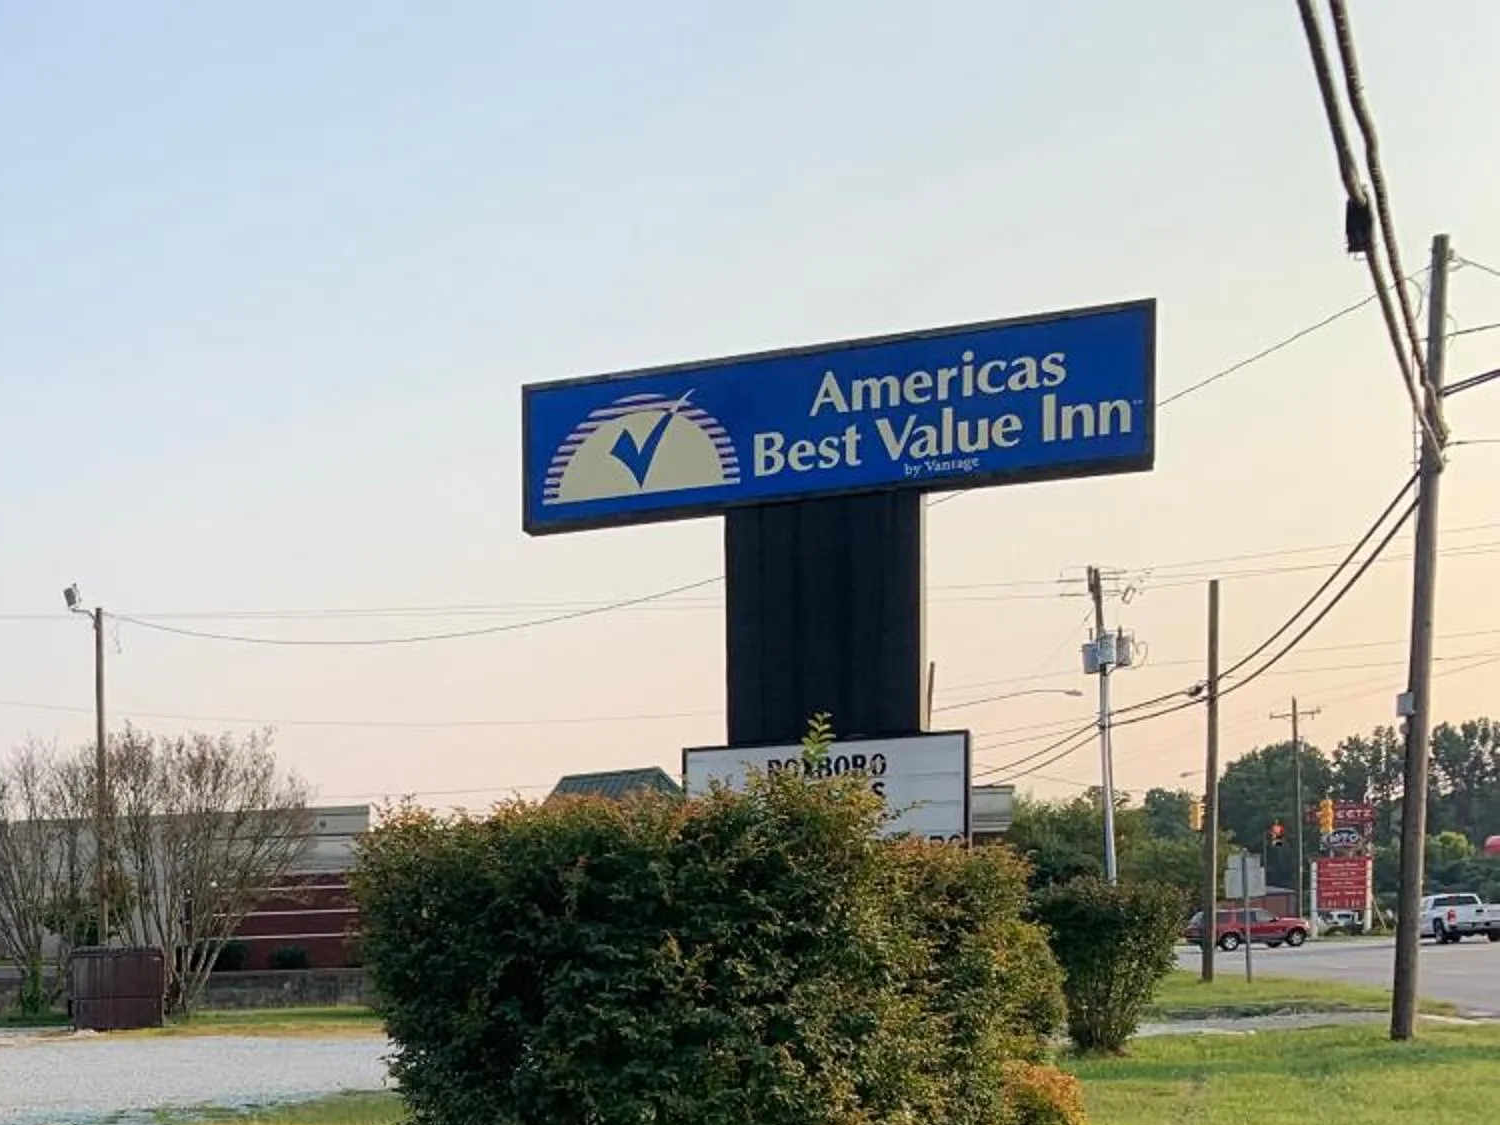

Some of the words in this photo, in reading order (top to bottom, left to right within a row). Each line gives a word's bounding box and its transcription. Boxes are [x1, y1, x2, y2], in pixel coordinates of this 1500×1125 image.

[809, 351, 1067, 416] Americas
[754, 424, 862, 477] Best
[876, 406, 1022, 461] Value
[1043, 394, 1132, 442] Inn
[904, 463, 921, 478] by
[924, 458, 979, 472] Vantage
